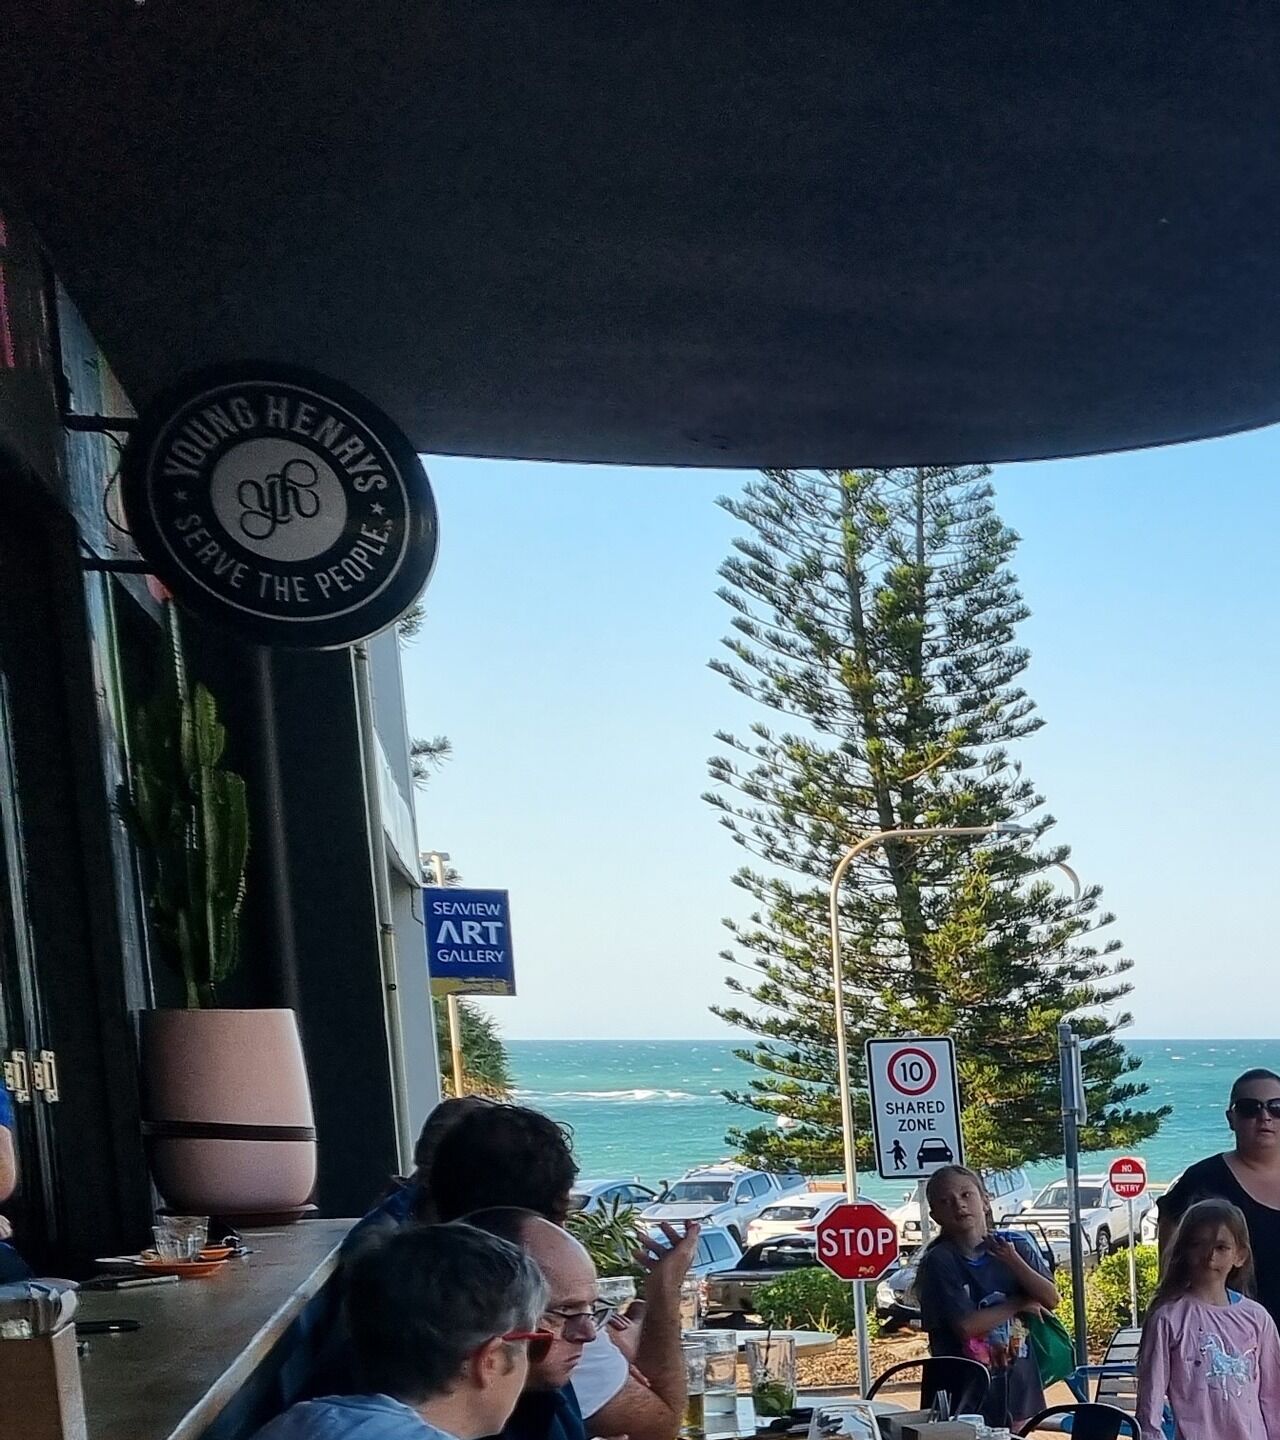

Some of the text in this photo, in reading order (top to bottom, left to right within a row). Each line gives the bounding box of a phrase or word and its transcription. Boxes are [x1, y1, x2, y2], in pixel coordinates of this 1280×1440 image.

[163, 395, 388, 493] YOUNG HENRYS
[175, 513, 249, 589] SERVE
[258, 571, 311, 602] THE
[432, 901, 501, 916] SEAVIEW
[436, 920, 504, 945] ART
[437, 949, 504, 962] GALLERY
[901, 1061, 924, 1082] 10
[886, 1100, 945, 1115] SHARED
[898, 1118, 936, 1132] ZONE
[1121, 1164, 1133, 1173] NO
[1115, 1184, 1140, 1193] ENTRY
[821, 1227, 894, 1257] STOP
